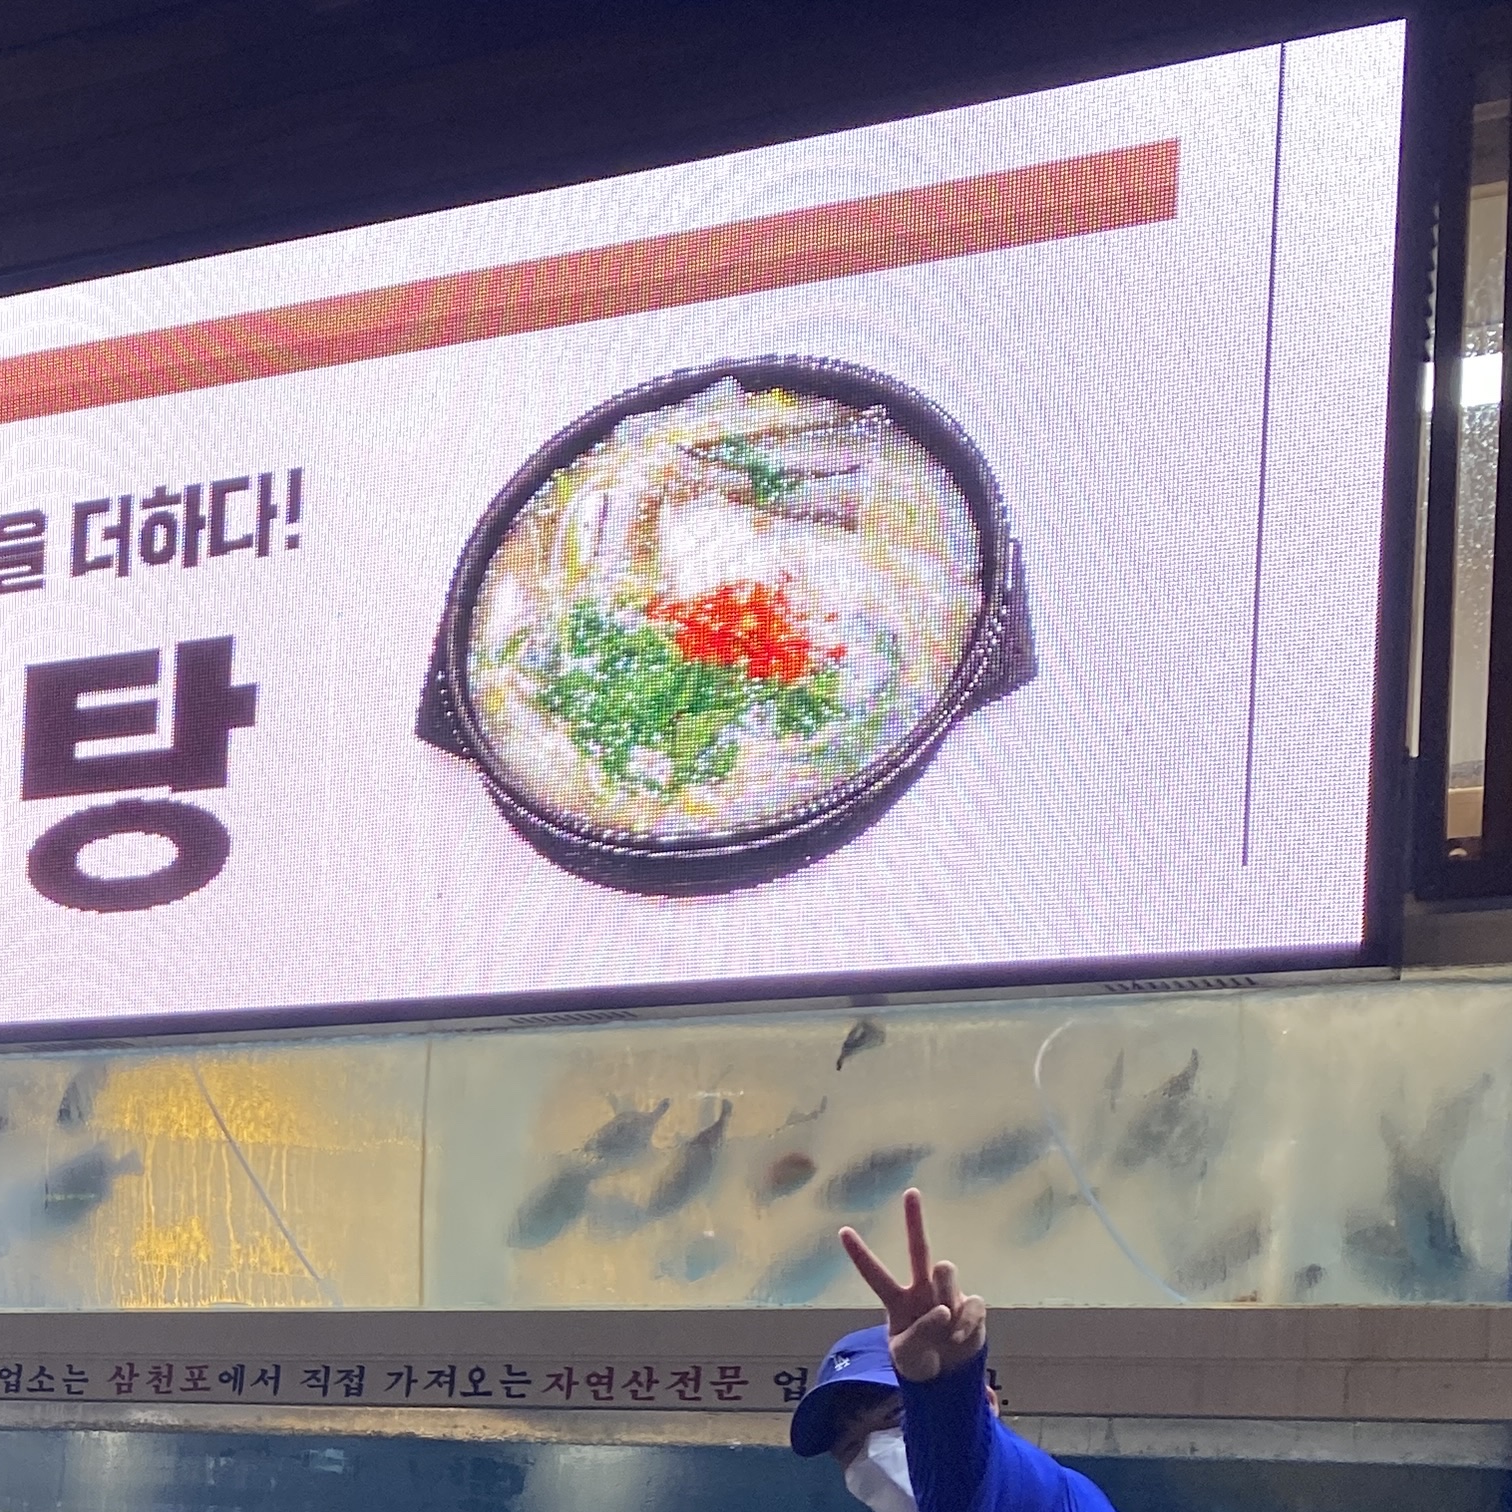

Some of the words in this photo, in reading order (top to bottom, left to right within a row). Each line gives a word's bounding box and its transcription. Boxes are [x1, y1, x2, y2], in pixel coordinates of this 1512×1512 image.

[70, 466, 304, 579] 더하다!
[107, 1362, 281, 1399] 삼천포에서
[299, 1364, 367, 1399] 직접
